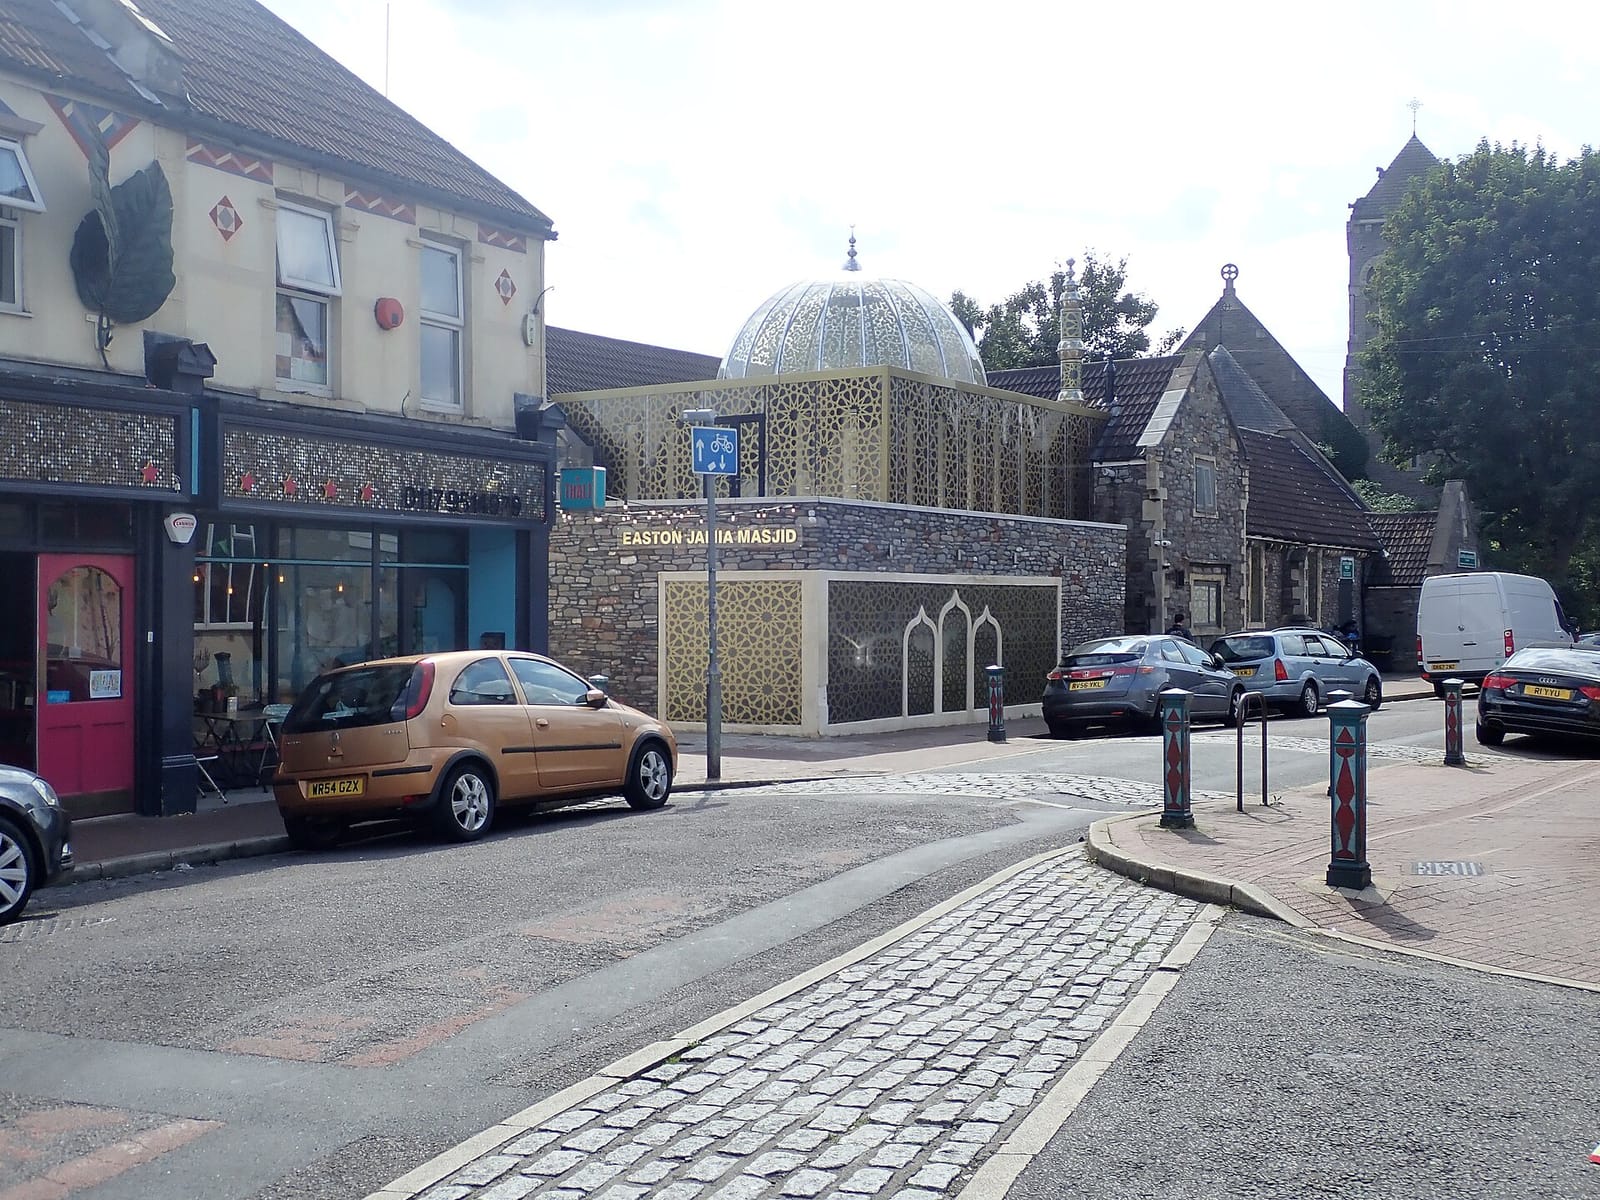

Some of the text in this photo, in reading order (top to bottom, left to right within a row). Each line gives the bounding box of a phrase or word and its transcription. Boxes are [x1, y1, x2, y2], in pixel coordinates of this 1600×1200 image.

[565, 483, 592, 499] THALI
[622, 530, 683, 545] EASTON
[738, 528, 797, 544] MASJID
[312, 780, 359, 795] WR54 GZX
